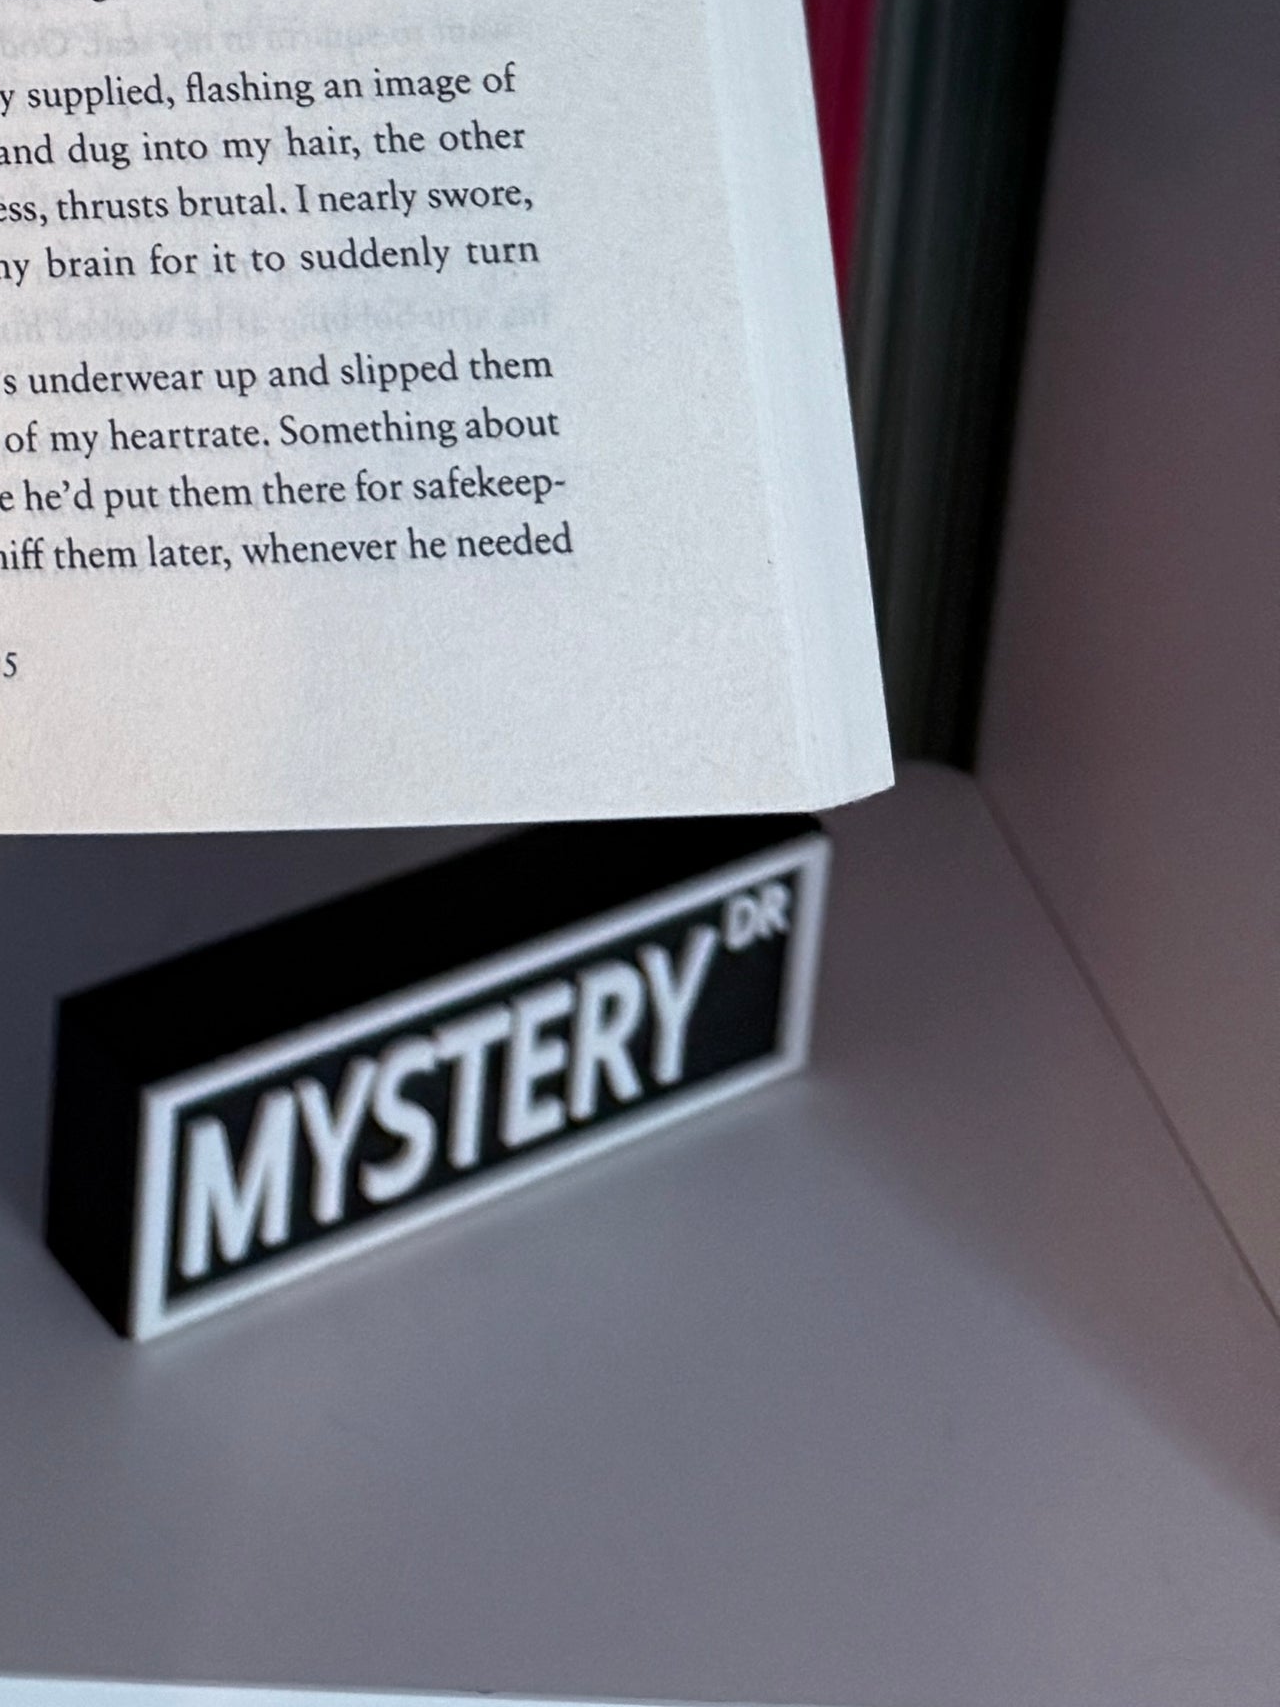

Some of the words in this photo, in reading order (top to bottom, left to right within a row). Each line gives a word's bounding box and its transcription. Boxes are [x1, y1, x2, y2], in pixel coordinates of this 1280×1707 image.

[3, 418, 39, 455] of
[48, 429, 100, 461] my
[106, 416, 271, 452] heartrate.
[278, 408, 459, 450] Something
[463, 404, 561, 441] about
[21, 476, 96, 513] he’d
[102, 484, 161, 520] put
[167, 473, 254, 509] them
[261, 470, 347, 507] there
[354, 467, 404, 504] for
[411, 463, 567, 506] safekeep-
[178, 923, 719, 1279] MYSTERY
[723, 881, 791, 951] DR
